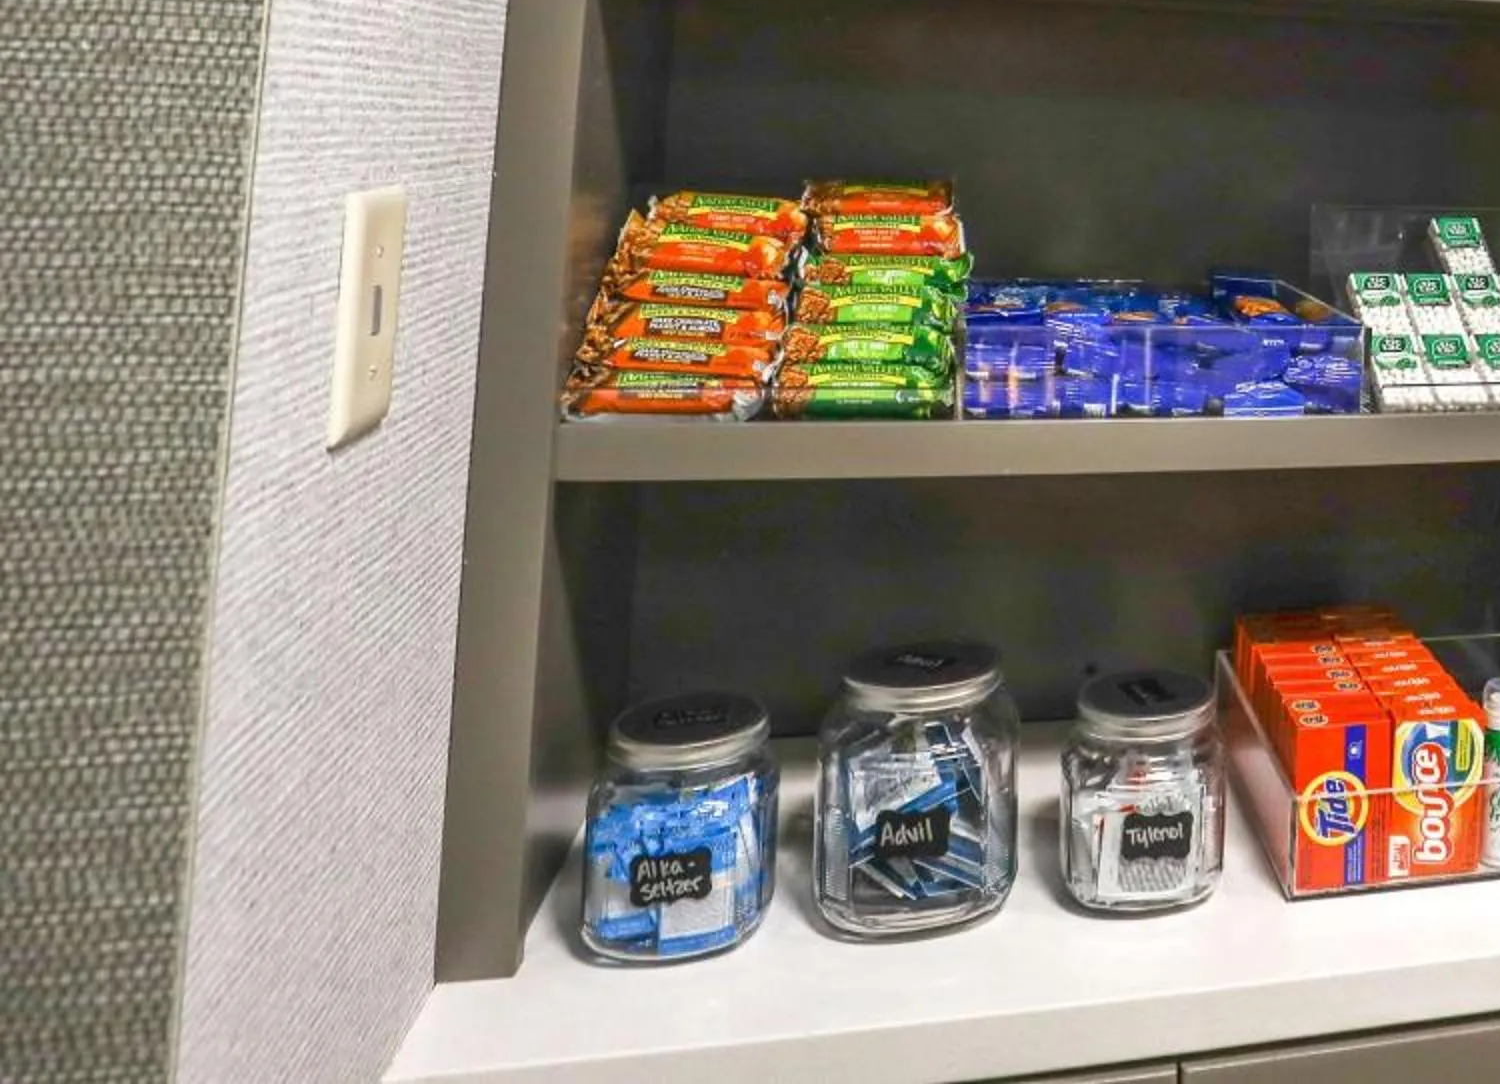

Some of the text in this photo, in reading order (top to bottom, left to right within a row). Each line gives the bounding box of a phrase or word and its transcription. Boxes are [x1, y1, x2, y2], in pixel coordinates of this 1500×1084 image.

[1317, 776, 1358, 841] Tide
[1413, 747, 1449, 864] bounce
[880, 819, 934, 848] Advil
[1126, 822, 1185, 849] Tylenol
